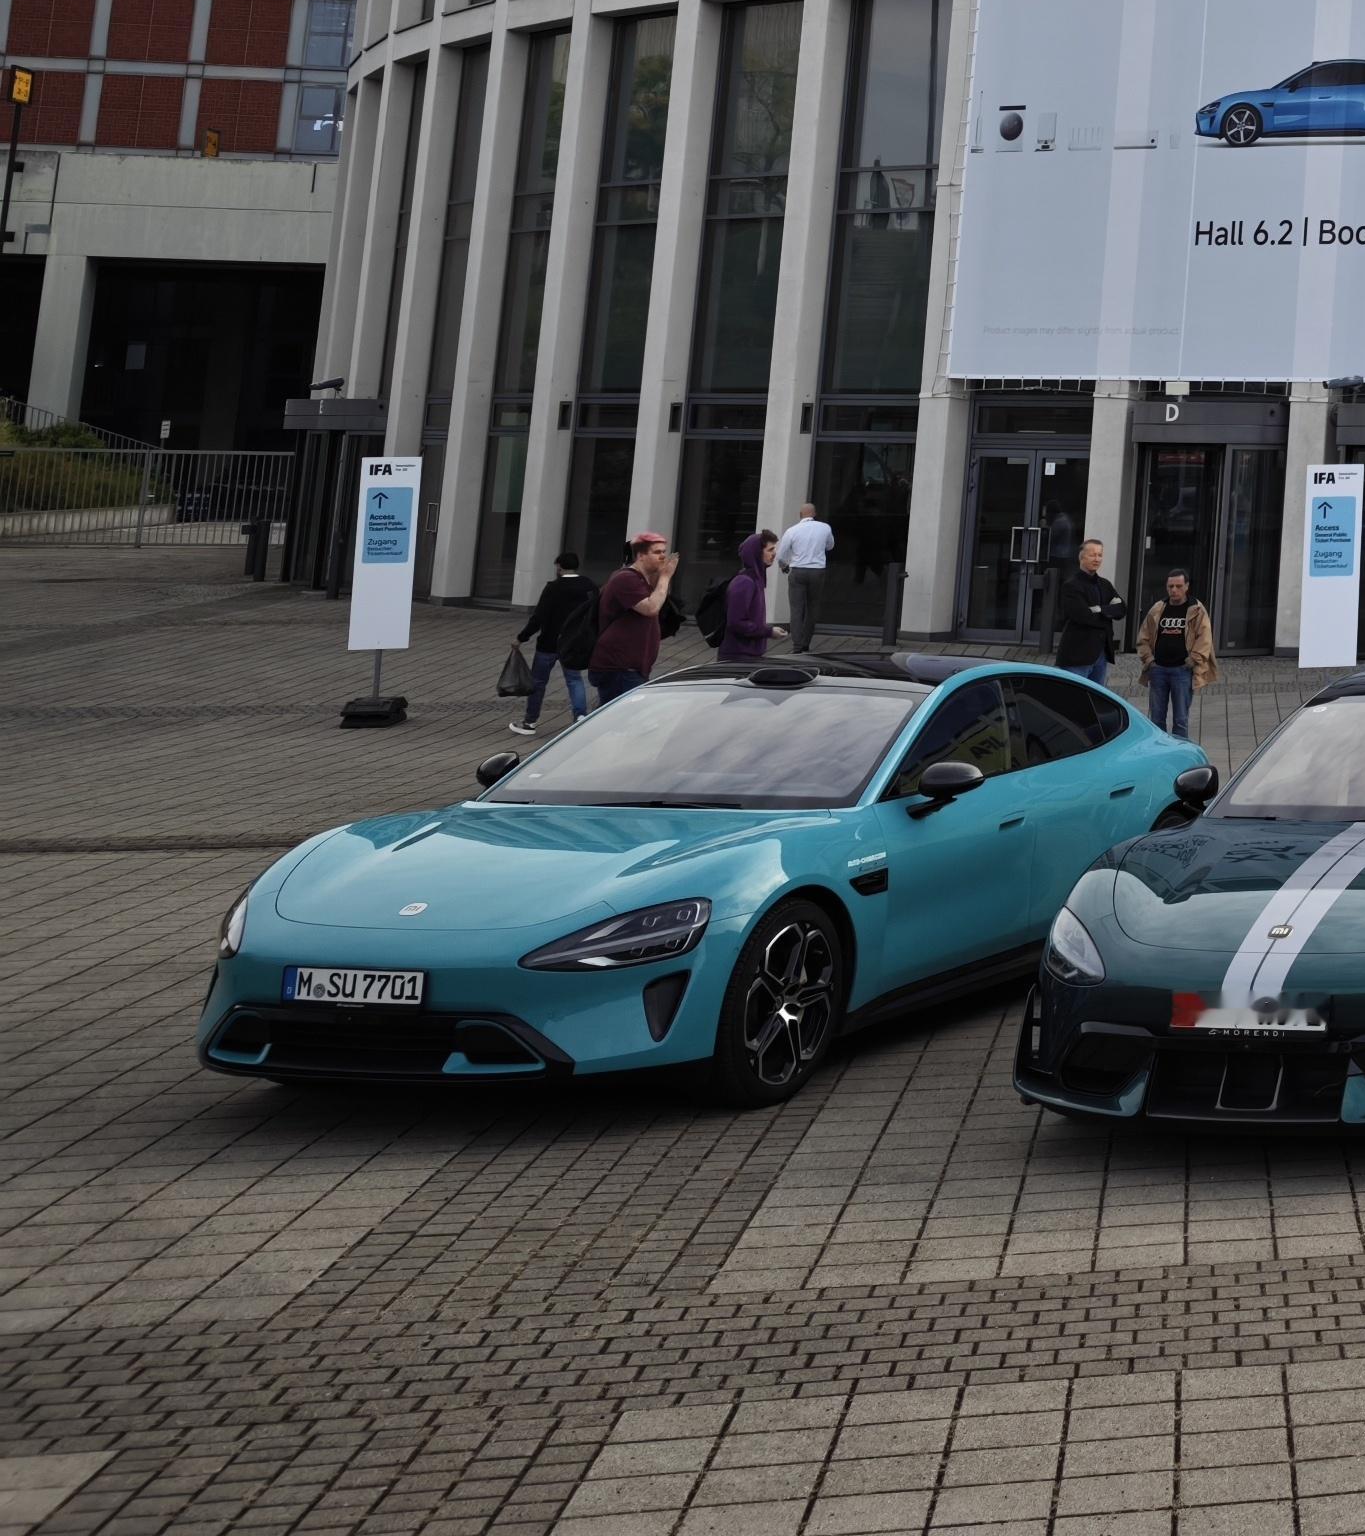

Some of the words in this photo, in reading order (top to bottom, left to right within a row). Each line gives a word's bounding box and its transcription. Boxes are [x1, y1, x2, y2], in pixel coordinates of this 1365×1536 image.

[1195, 219, 1244, 245] Hall
[1253, 219, 1292, 245] 6.2
[1165, 404, 1179, 422] D
[369, 464, 392, 475] IFA
[1314, 472, 1335, 484] IFA
[368, 538, 397, 546] Zugang
[1313, 551, 1342, 559] Zugang
[297, 970, 313, 997] M
[327, 972, 358, 999] SU
[363, 974, 419, 1000] 7701
[1223, 1029, 1286, 1037] MORENDI
